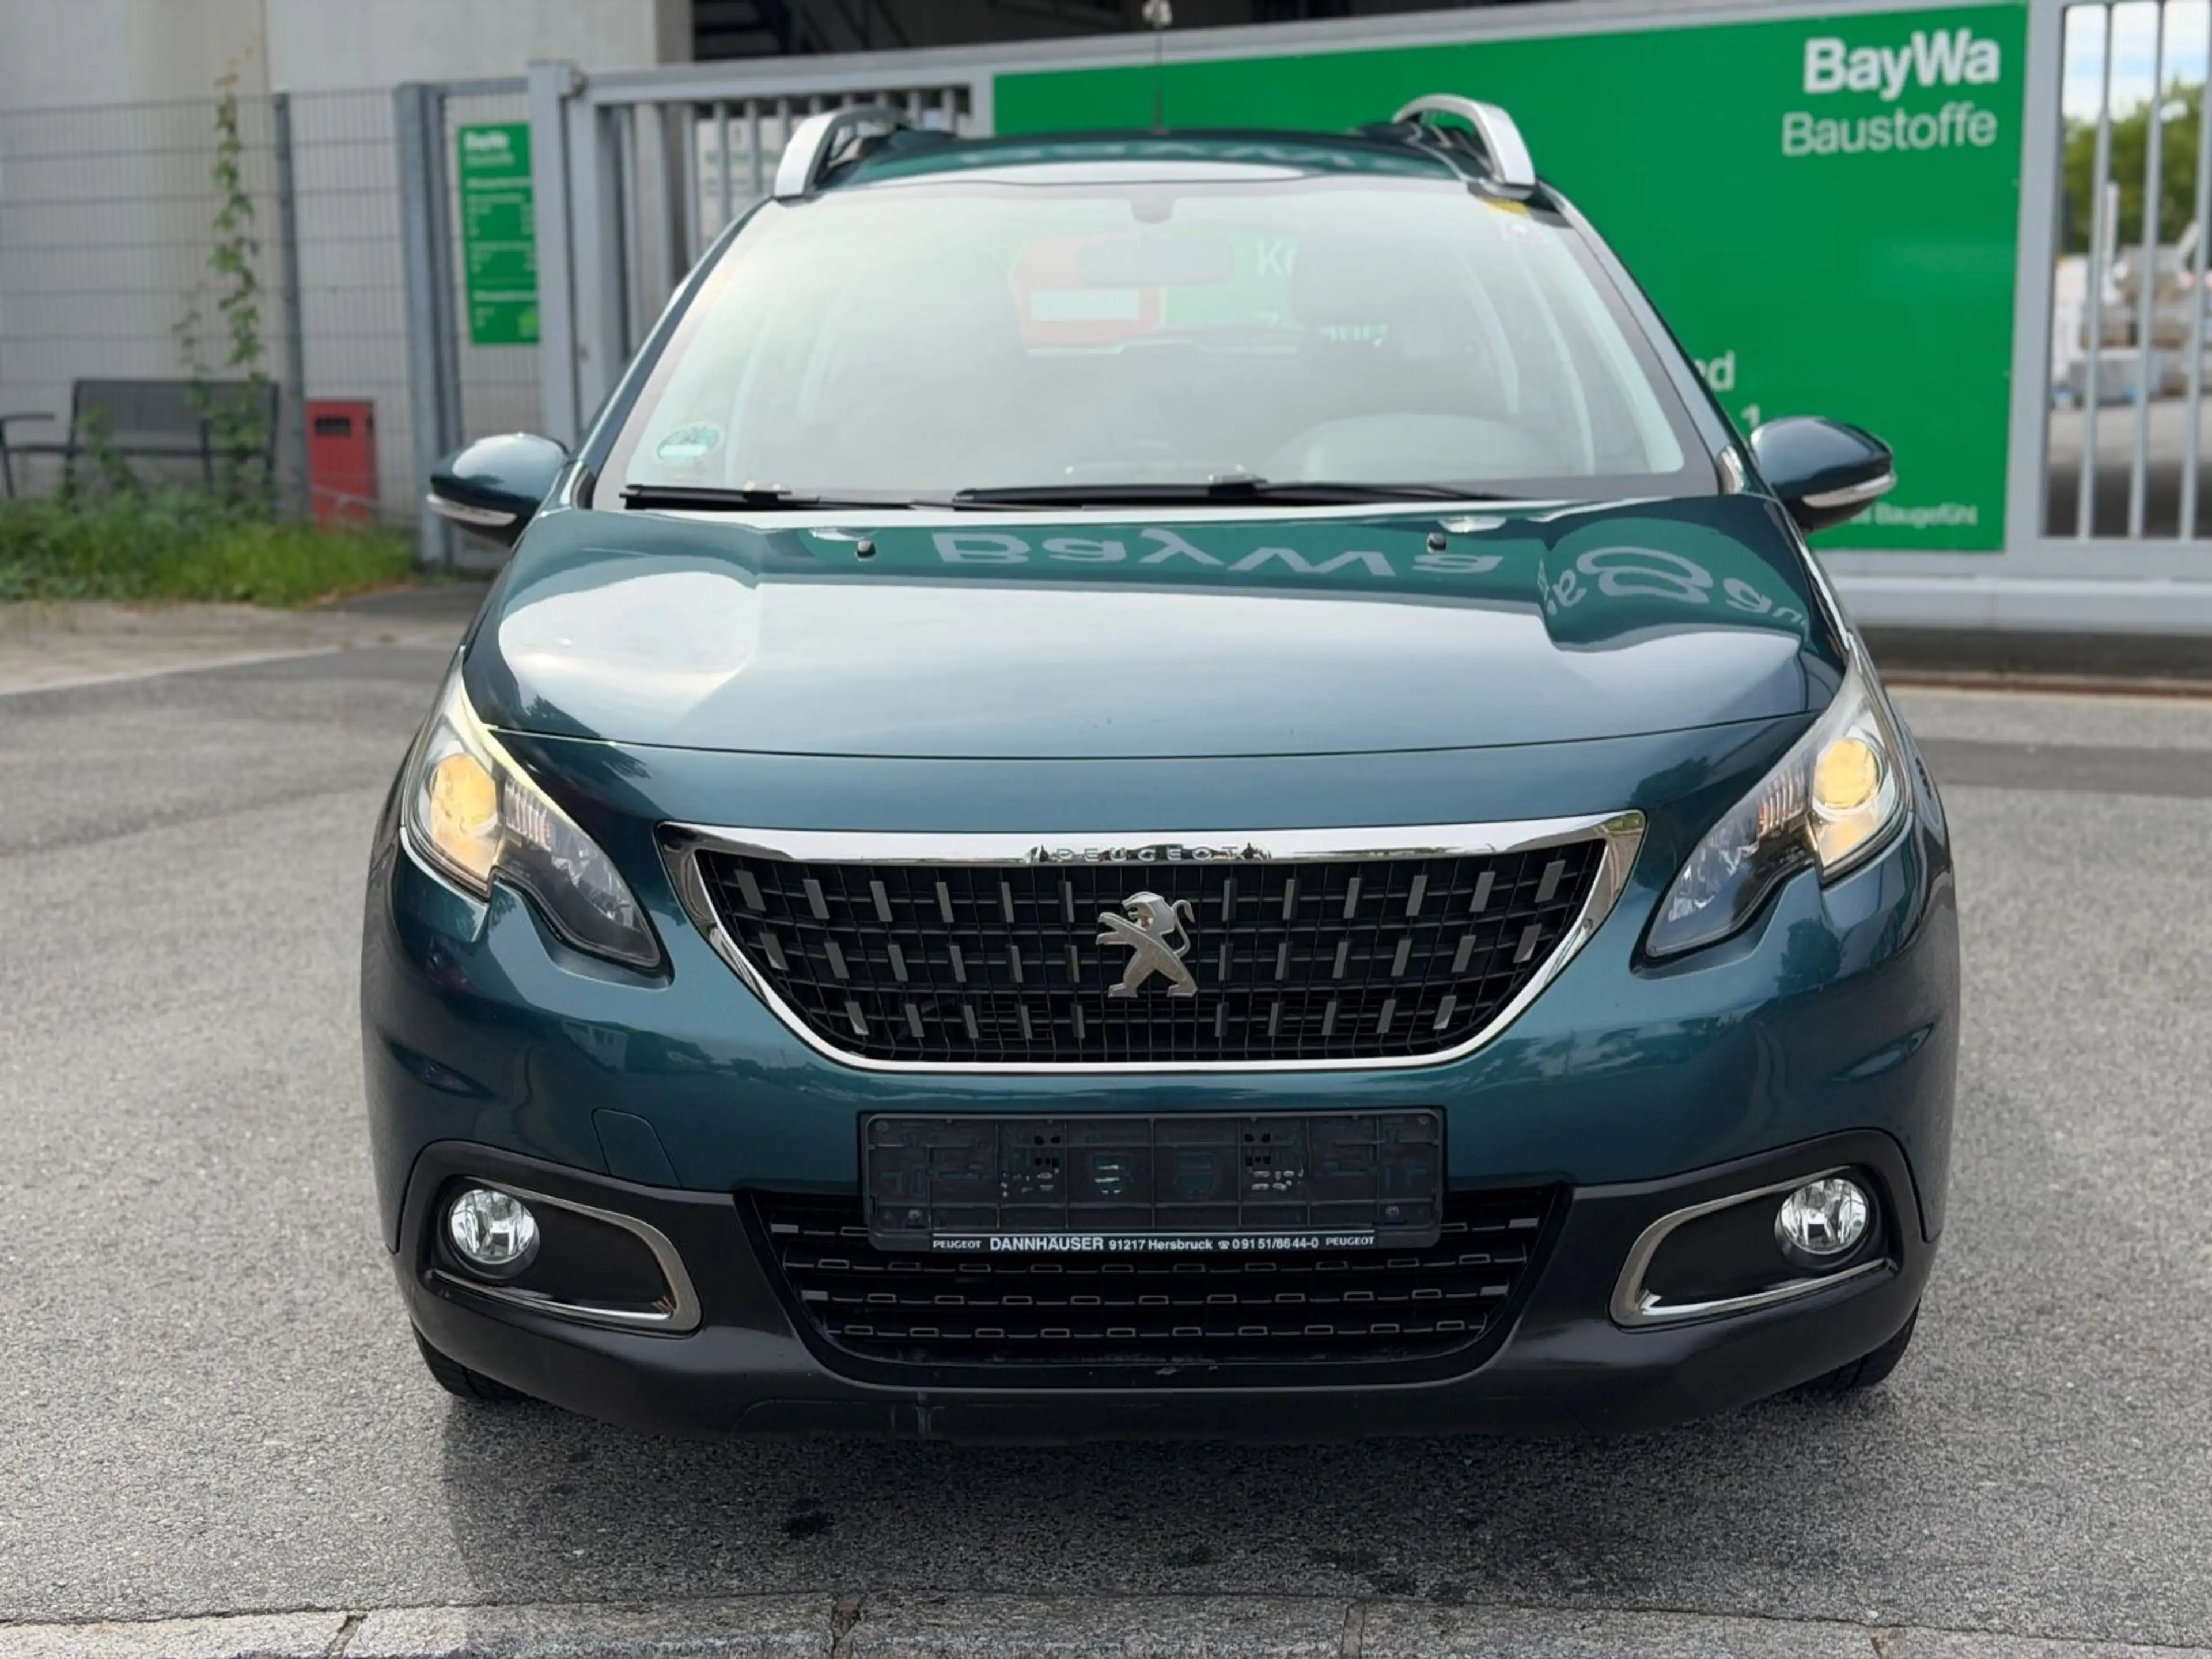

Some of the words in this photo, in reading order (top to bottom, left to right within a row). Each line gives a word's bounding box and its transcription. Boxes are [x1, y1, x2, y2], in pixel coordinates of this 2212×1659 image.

[1803, 26, 2001, 103] BayWa
[1781, 100, 1998, 156] Baustoffe
[1056, 844, 1240, 862] PEUGEOT
[933, 1240, 982, 1250] PEUGEOT
[989, 1234, 1104, 1251] DANNHÄUSER
[1108, 1239, 1145, 1251] 91217
[1147, 1237, 1213, 1251] Hersbruck
[1325, 1236, 1375, 1246] PEUGEOT
